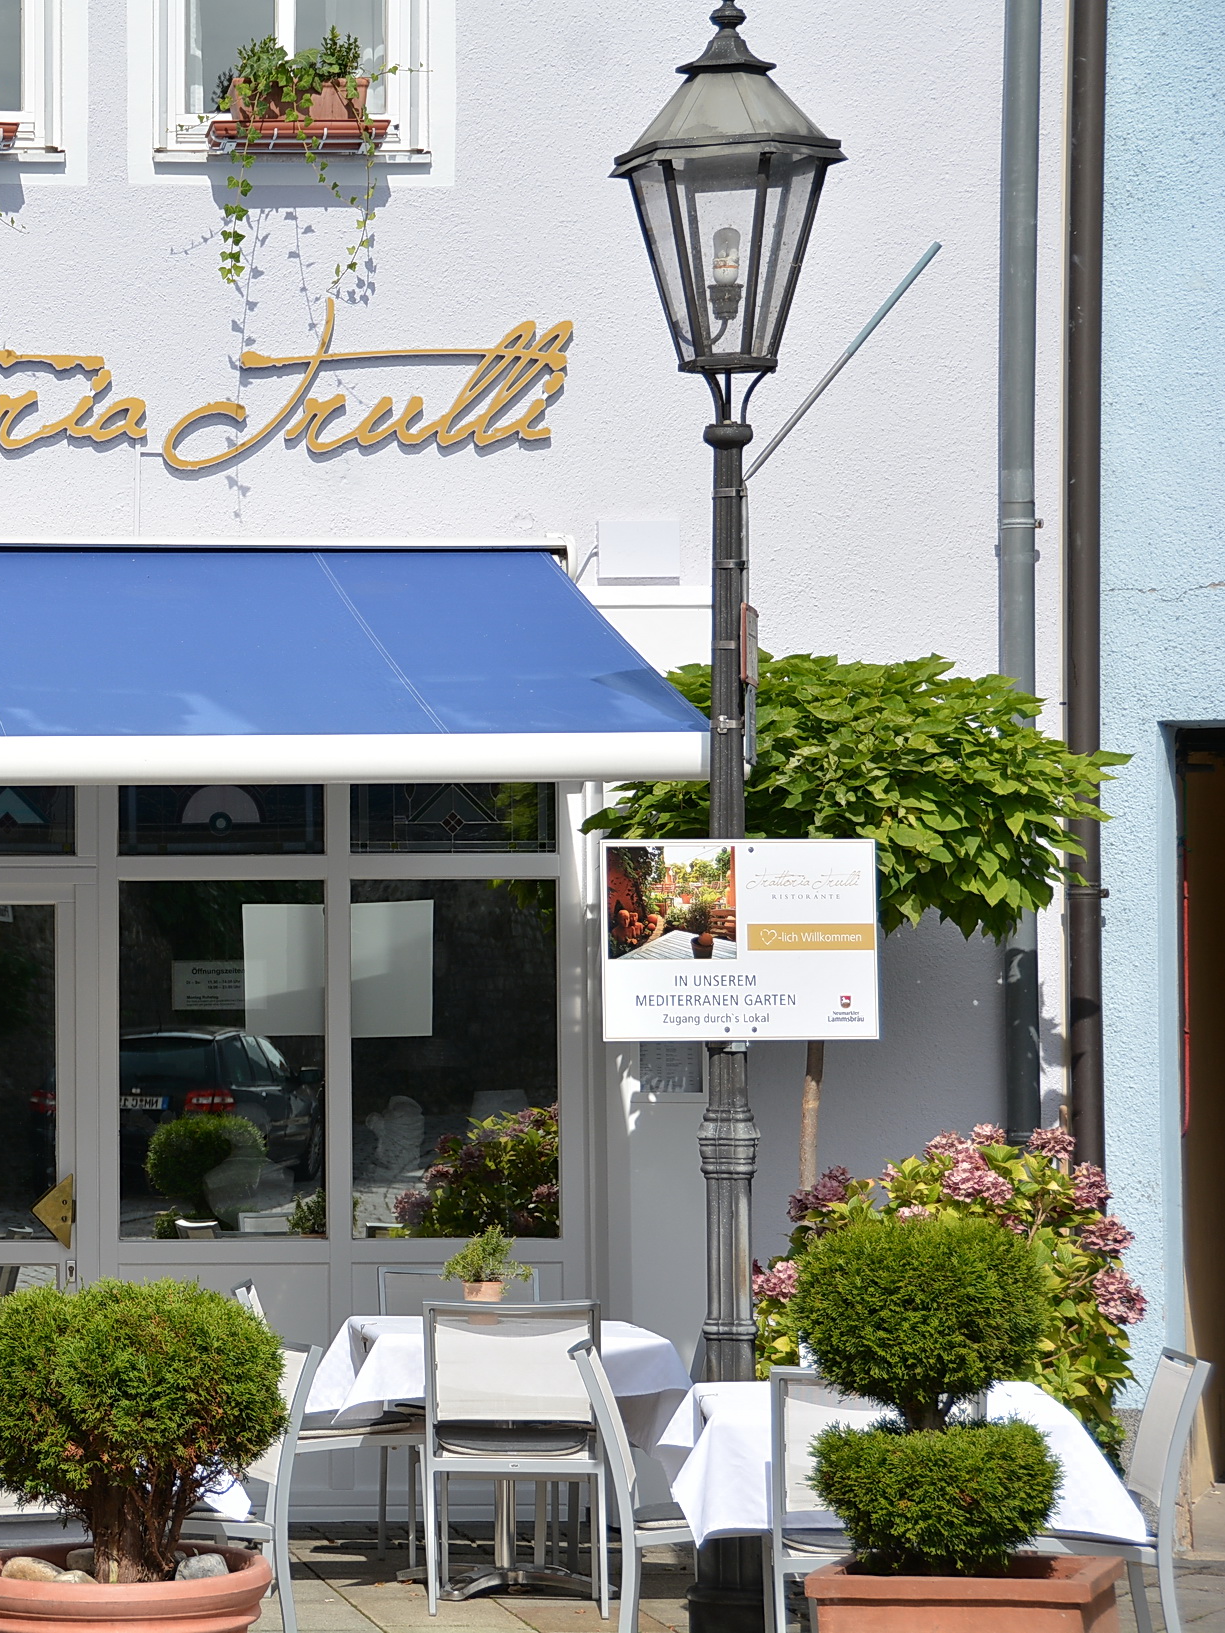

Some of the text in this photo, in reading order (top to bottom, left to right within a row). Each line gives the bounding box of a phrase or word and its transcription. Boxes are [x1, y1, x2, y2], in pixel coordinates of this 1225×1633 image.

[163, 297, 573, 469] Trulli
[745, 867, 861, 890] Trattoria Trulli
[801, 931, 862, 943] Willkommen
[674, 974, 757, 987] IN UNSEREM
[635, 994, 796, 1007] MEDITERRANEN GARTEN
[662, 1013, 700, 1025] Zugang
[743, 1012, 770, 1023] Lokal
[827, 1015, 865, 1023] Lammsbräu
